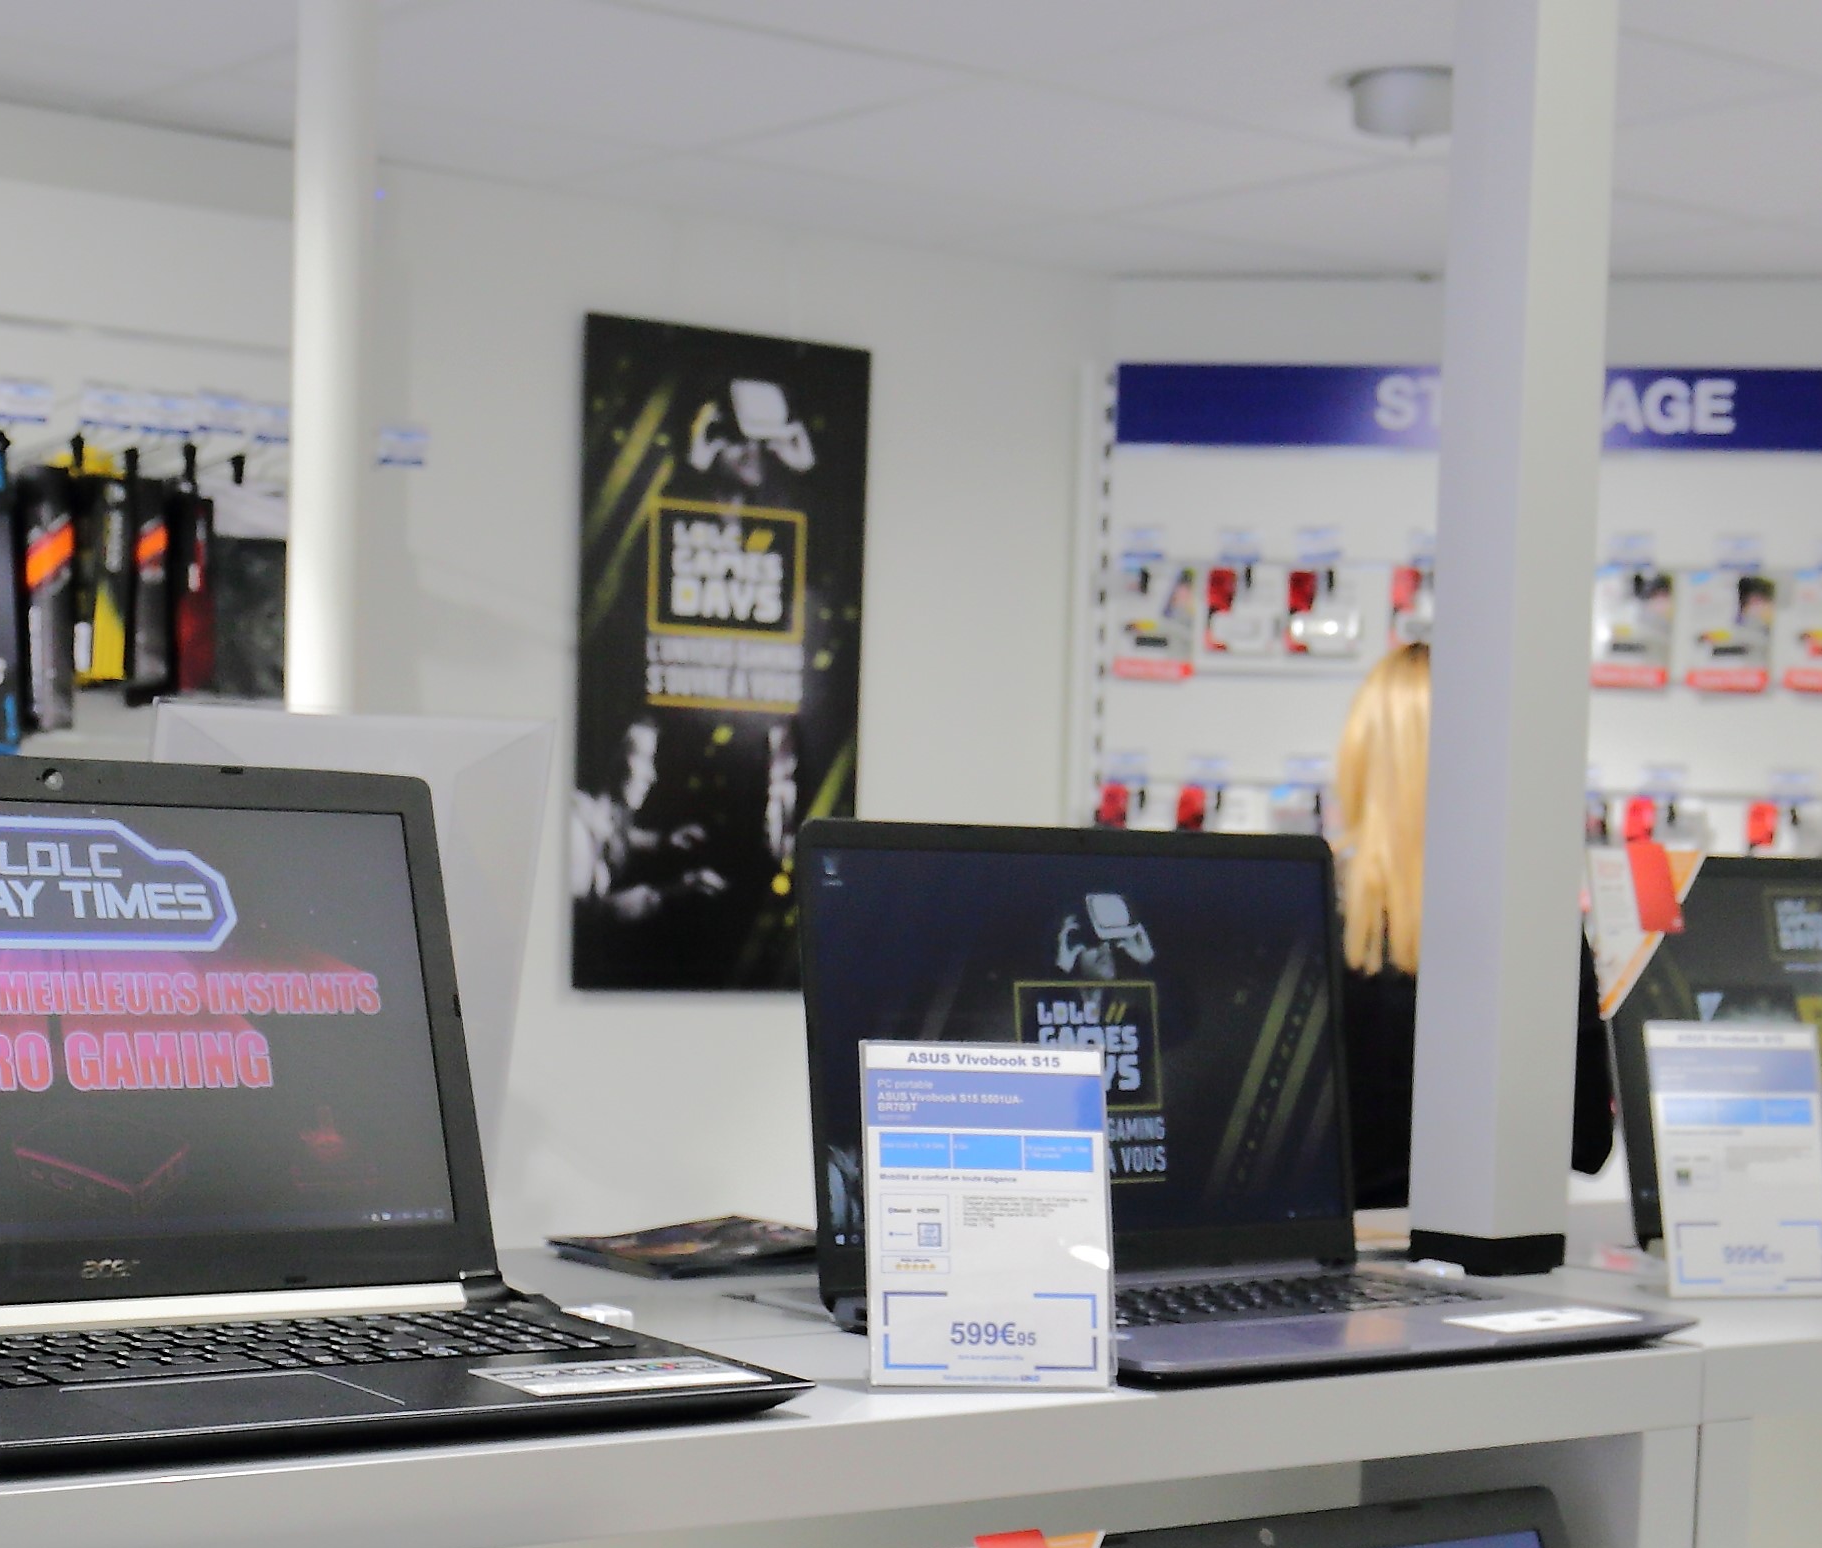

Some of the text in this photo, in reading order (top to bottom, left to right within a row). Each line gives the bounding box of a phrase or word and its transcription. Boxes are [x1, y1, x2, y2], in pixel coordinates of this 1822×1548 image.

[671, 576, 784, 625] DAYS
[59, 880, 212, 922] TIMES
[207, 971, 381, 1015] INSTANTS
[1037, 1001, 1101, 1025] LDLC
[67, 1031, 274, 1090] GAMING
[907, 1052, 1061, 1068] ASUS Vivobook S15
[877, 1079, 934, 1090] PC portable
[878, 1092, 907, 1101] ASUS
[910, 1092, 957, 1103] Vivobook
[1120, 1145, 1168, 1174] VOUS
[950, 1321, 1037, 1346] 599€95
